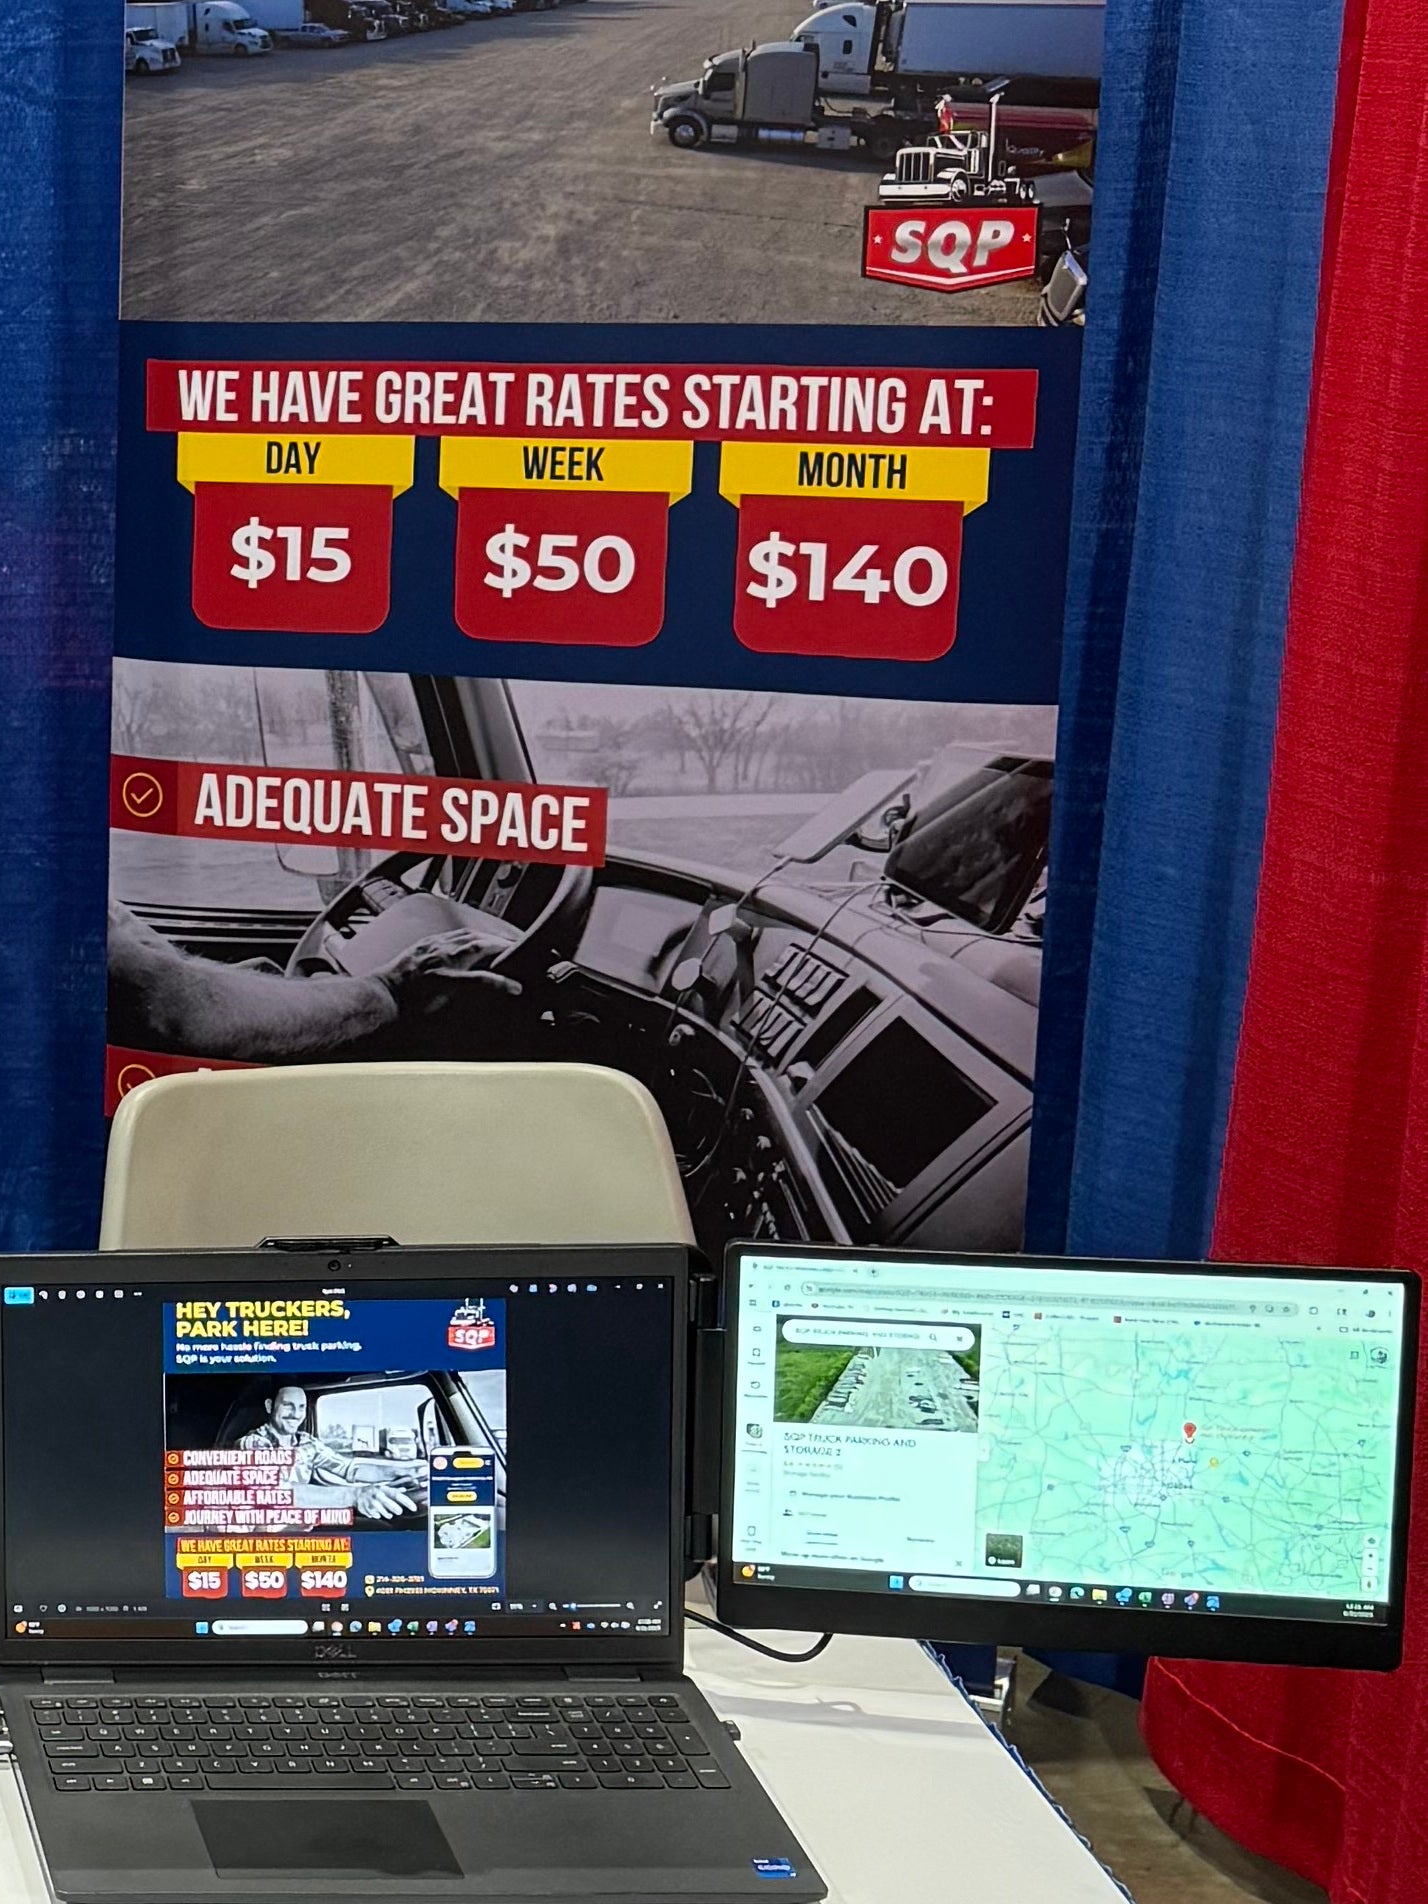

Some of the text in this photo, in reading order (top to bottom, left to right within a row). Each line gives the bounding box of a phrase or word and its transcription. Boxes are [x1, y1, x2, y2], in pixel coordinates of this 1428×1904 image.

[890, 219, 1015, 270] SQP
[179, 370, 992, 434] WE HAVE GREAT RATES STARTING AT:
[267, 442, 320, 474] DAY
[524, 447, 604, 480] WEEK
[799, 452, 906, 489] MONTH
[231, 517, 350, 588] $15
[485, 524, 634, 597] $50
[747, 532, 947, 607] $140
[195, 774, 597, 851] ADEQUATE SPACE
[176, 1300, 351, 1320] HEY TRUCKERS,
[176, 1320, 309, 1338] PARK HERE!
[453, 1328, 489, 1345] SQP
[253, 1341, 291, 1354] finding
[893, 1437, 916, 1448] AND
[183, 1450, 293, 1465] CONVENIENT ROADS
[183, 1470, 278, 1485] ADEQUATE SPACE
[184, 1490, 292, 1505] AFFORDABLE RATES
[184, 1509, 351, 1525] JOURNEY WITH PEACE OF MIND
[181, 1539, 196, 1552] WE
[198, 1539, 223, 1552] HAVE
[224, 1539, 254, 1552] GREAT
[255, 1539, 286, 1552] RATES
[287, 1539, 332, 1552] STARTING
[188, 1571, 221, 1590] $15
[245, 1570, 284, 1590] $50
[301, 1570, 348, 1590] $140
